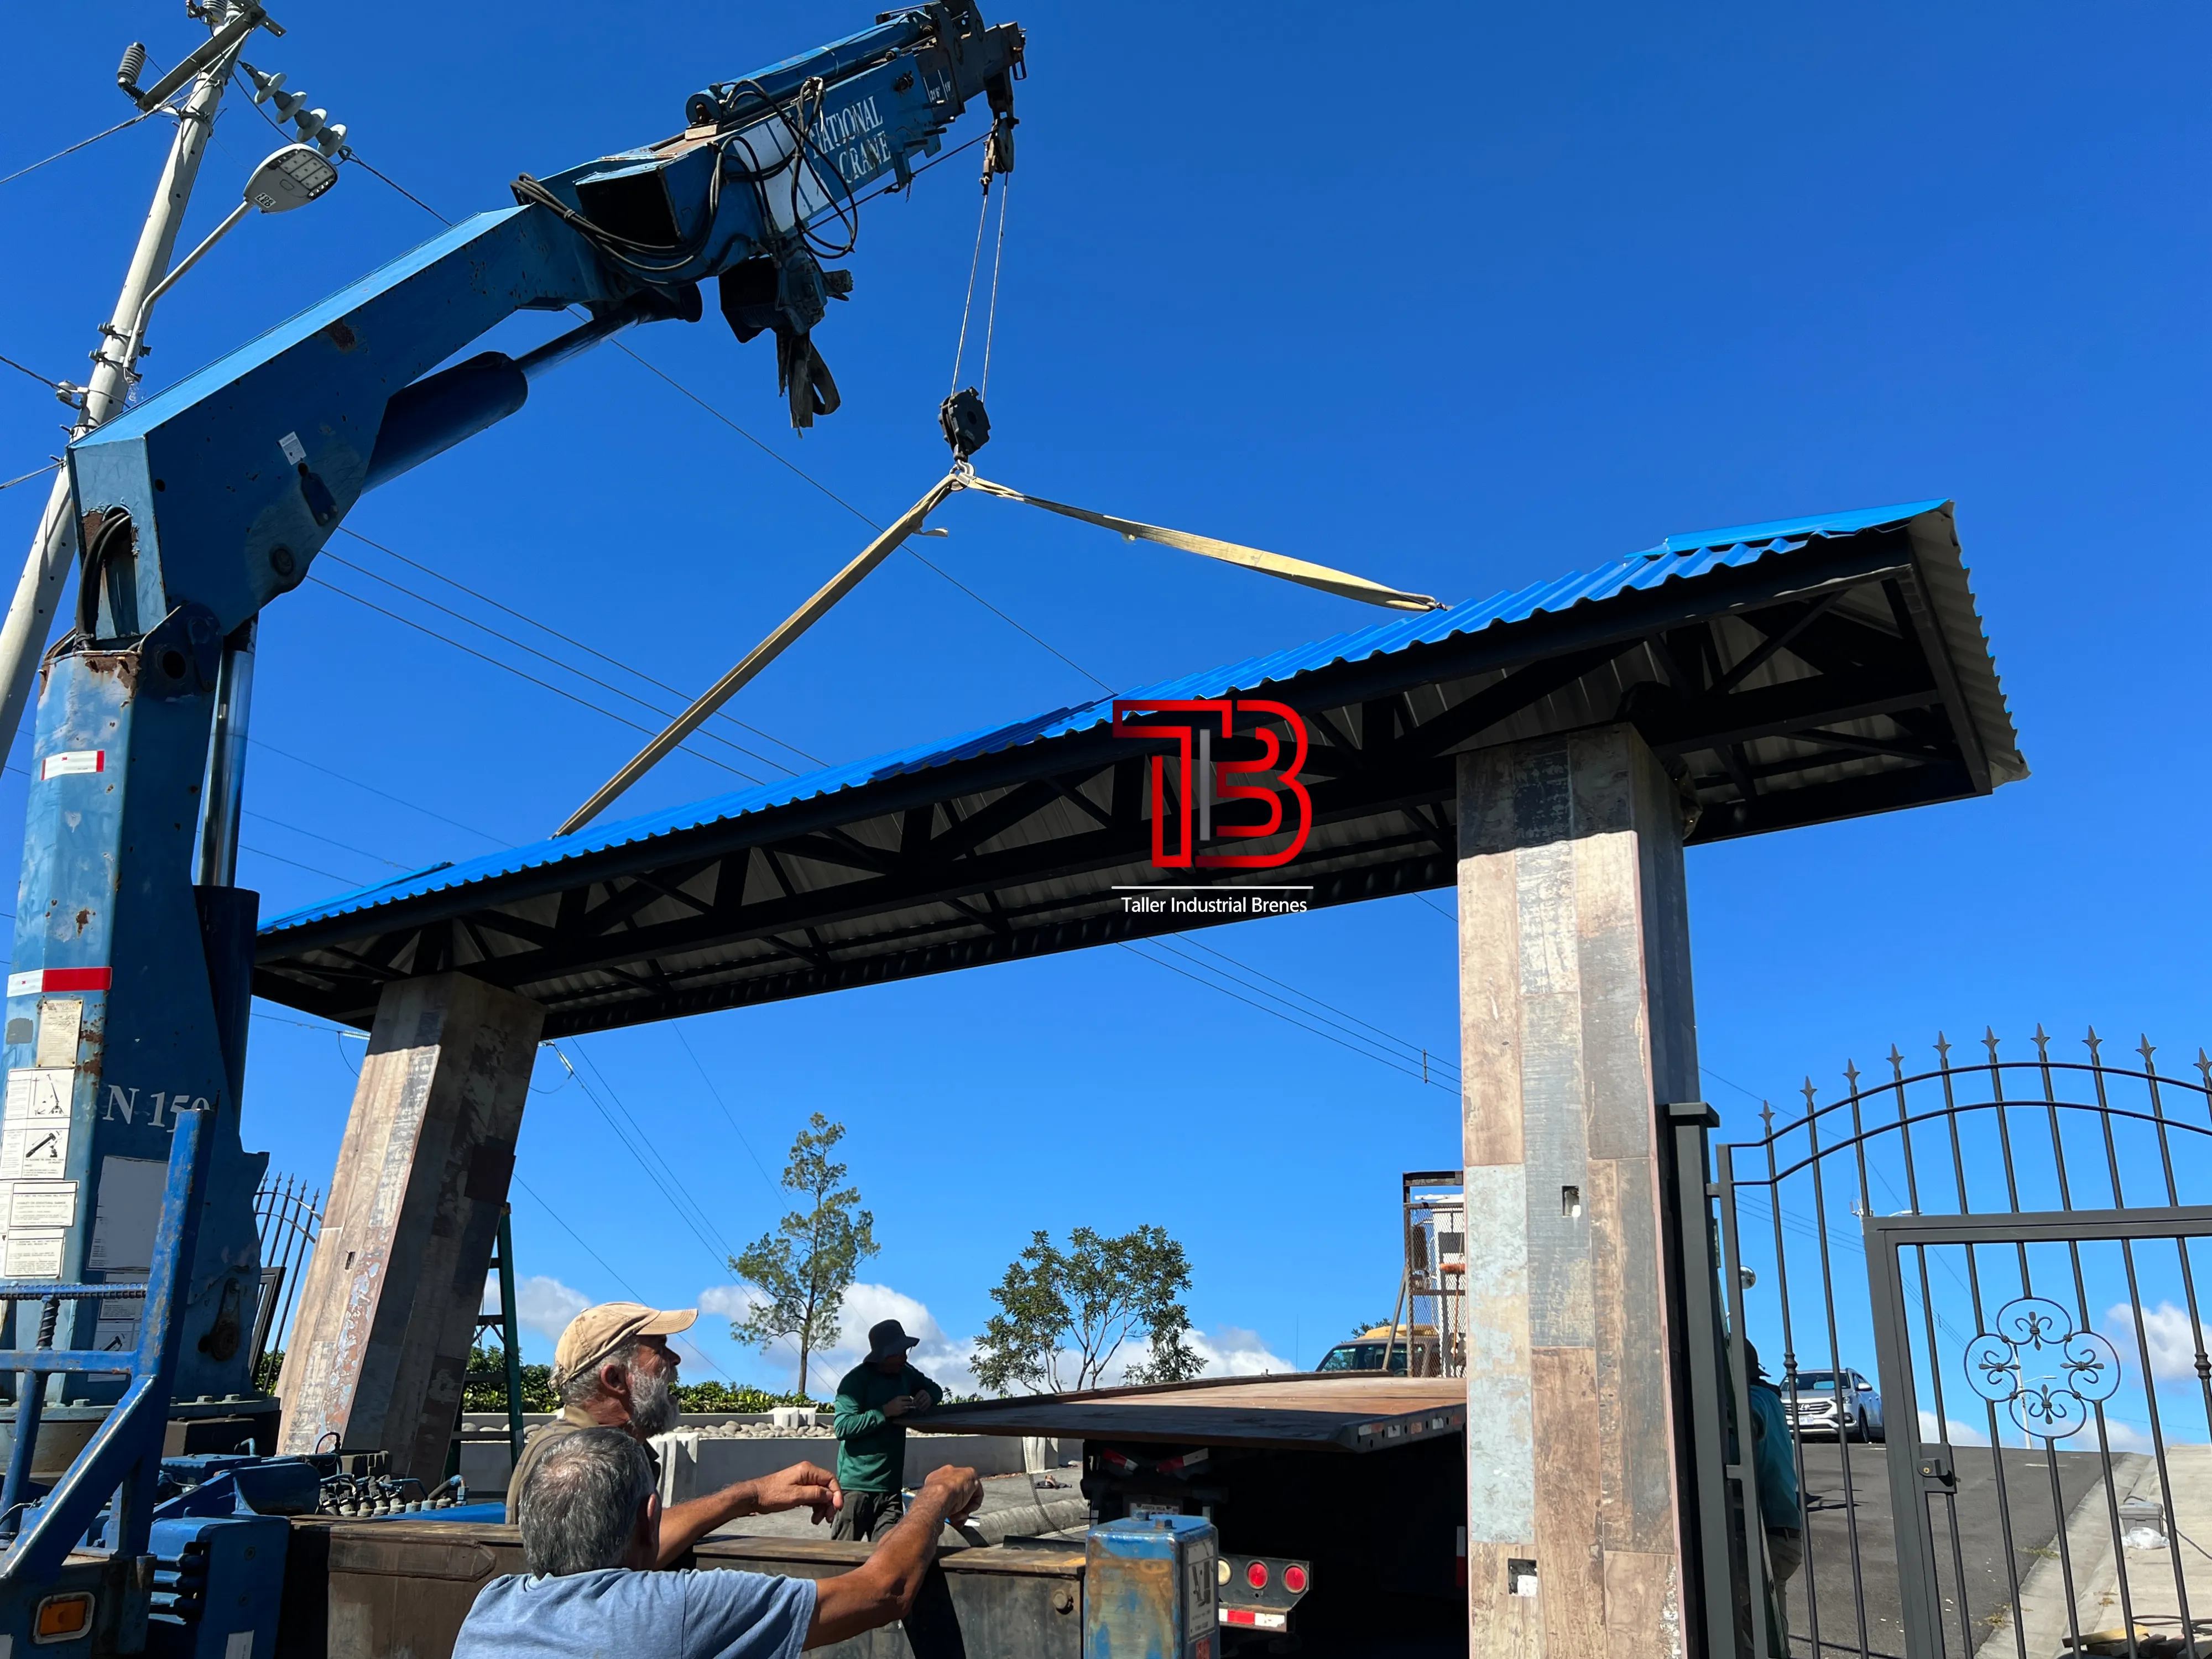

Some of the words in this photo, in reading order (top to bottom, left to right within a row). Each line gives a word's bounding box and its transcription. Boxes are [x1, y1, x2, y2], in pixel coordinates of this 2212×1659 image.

[808, 96, 883, 159] NATIONAL
[839, 131, 891, 183] CRANE
[257, 196, 270, 206] LED
[102, 1084, 140, 1124] N
